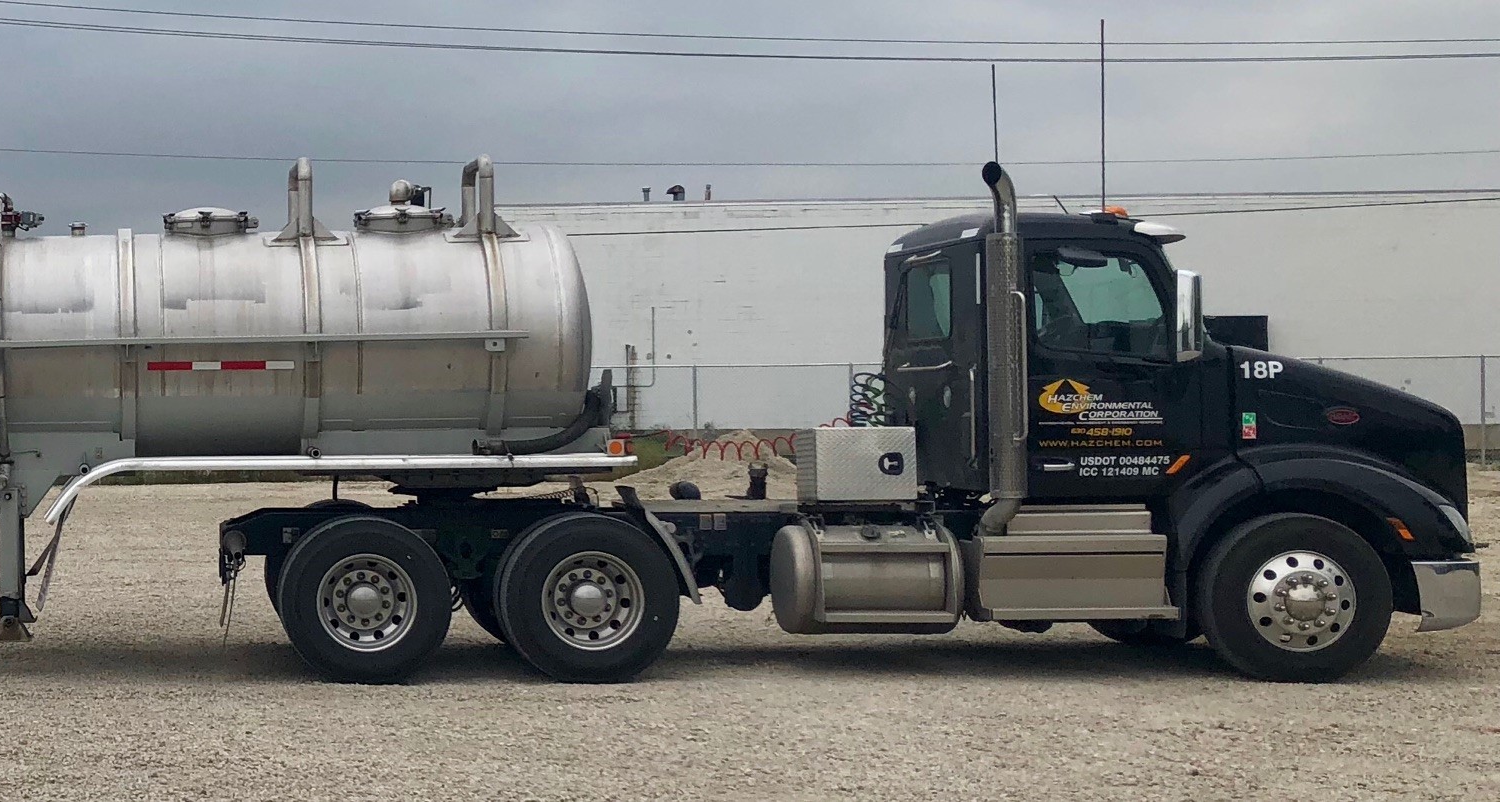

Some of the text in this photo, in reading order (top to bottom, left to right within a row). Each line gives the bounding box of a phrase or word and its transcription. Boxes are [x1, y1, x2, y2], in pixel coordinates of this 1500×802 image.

[1240, 361, 1284, 379] 18P
[1047, 394, 1103, 404] HAZCHEM
[1061, 401, 1153, 412] ENVIRONMENTAL
[1078, 410, 1159, 420] CORPORATION
[1080, 455, 1170, 466] USDOT 00484475
[1079, 466, 1160, 477] ICC 121409 MC
